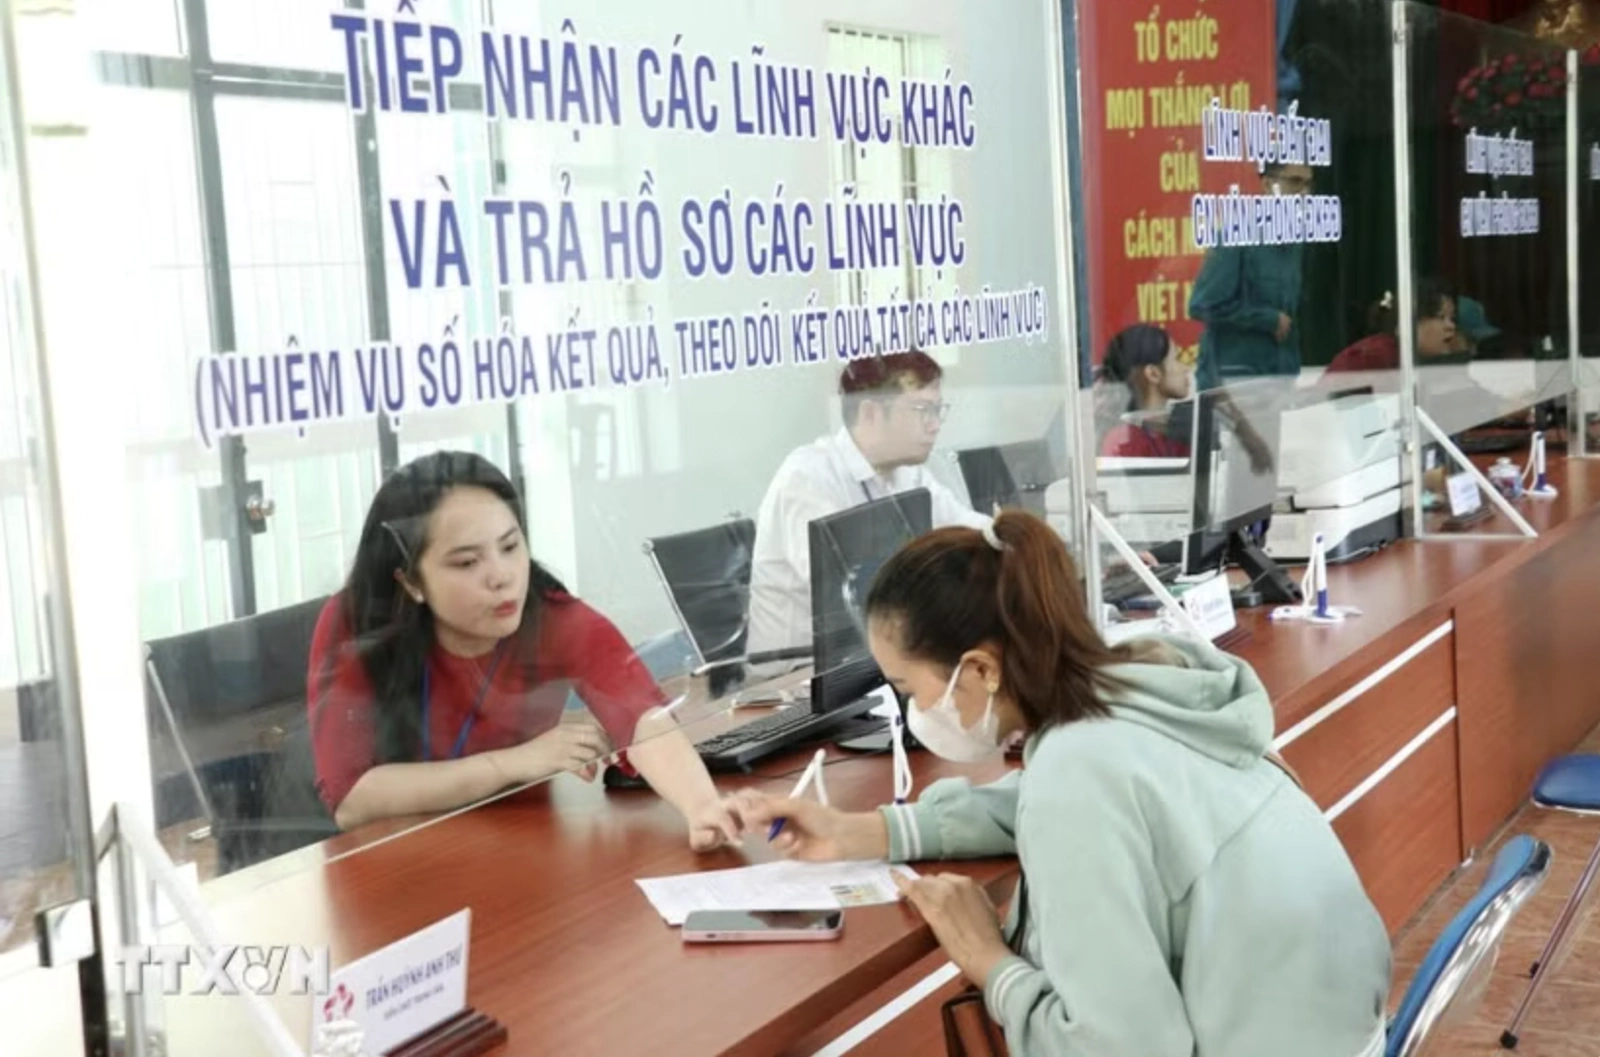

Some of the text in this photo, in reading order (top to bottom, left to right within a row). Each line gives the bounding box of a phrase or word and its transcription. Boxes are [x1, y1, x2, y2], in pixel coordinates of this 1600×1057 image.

[1134, 4, 1219, 63] TỔ CHỨC
[330, 0, 975, 158] TIẾP NHẬN CÁC LĨNH VỰC KHÁC
[1106, 86, 1144, 139] MỌI
[1202, 97, 1331, 173] LĨNH VỰC ĐẤT ĐAI
[1160, 138, 1200, 192] CỦA
[389, 170, 965, 289] VÀ TRẢ HỒ SƠ CÁC LĨNH VỰC
[1124, 209, 1176, 259] CÁCH
[1137, 274, 1179, 329] VIỆT
[195, 335, 344, 448] (NHIỆM
[355, 345, 404, 426] VỤ
[417, 315, 462, 408] SỐ
[474, 320, 539, 400] HÓA
[547, 307, 597, 393] KẾT
[608, 305, 669, 387] QUẢ,
[674, 317, 736, 375] THEO
[744, 301, 781, 366] DÕI
[792, 291, 828, 364] KẾT
[834, 289, 874, 359] QUẢ
[876, 286, 909, 352] TẤT
[915, 286, 938, 348] CẢ
[941, 287, 973, 344] CÁC
[976, 286, 1011, 341] LĨNH
